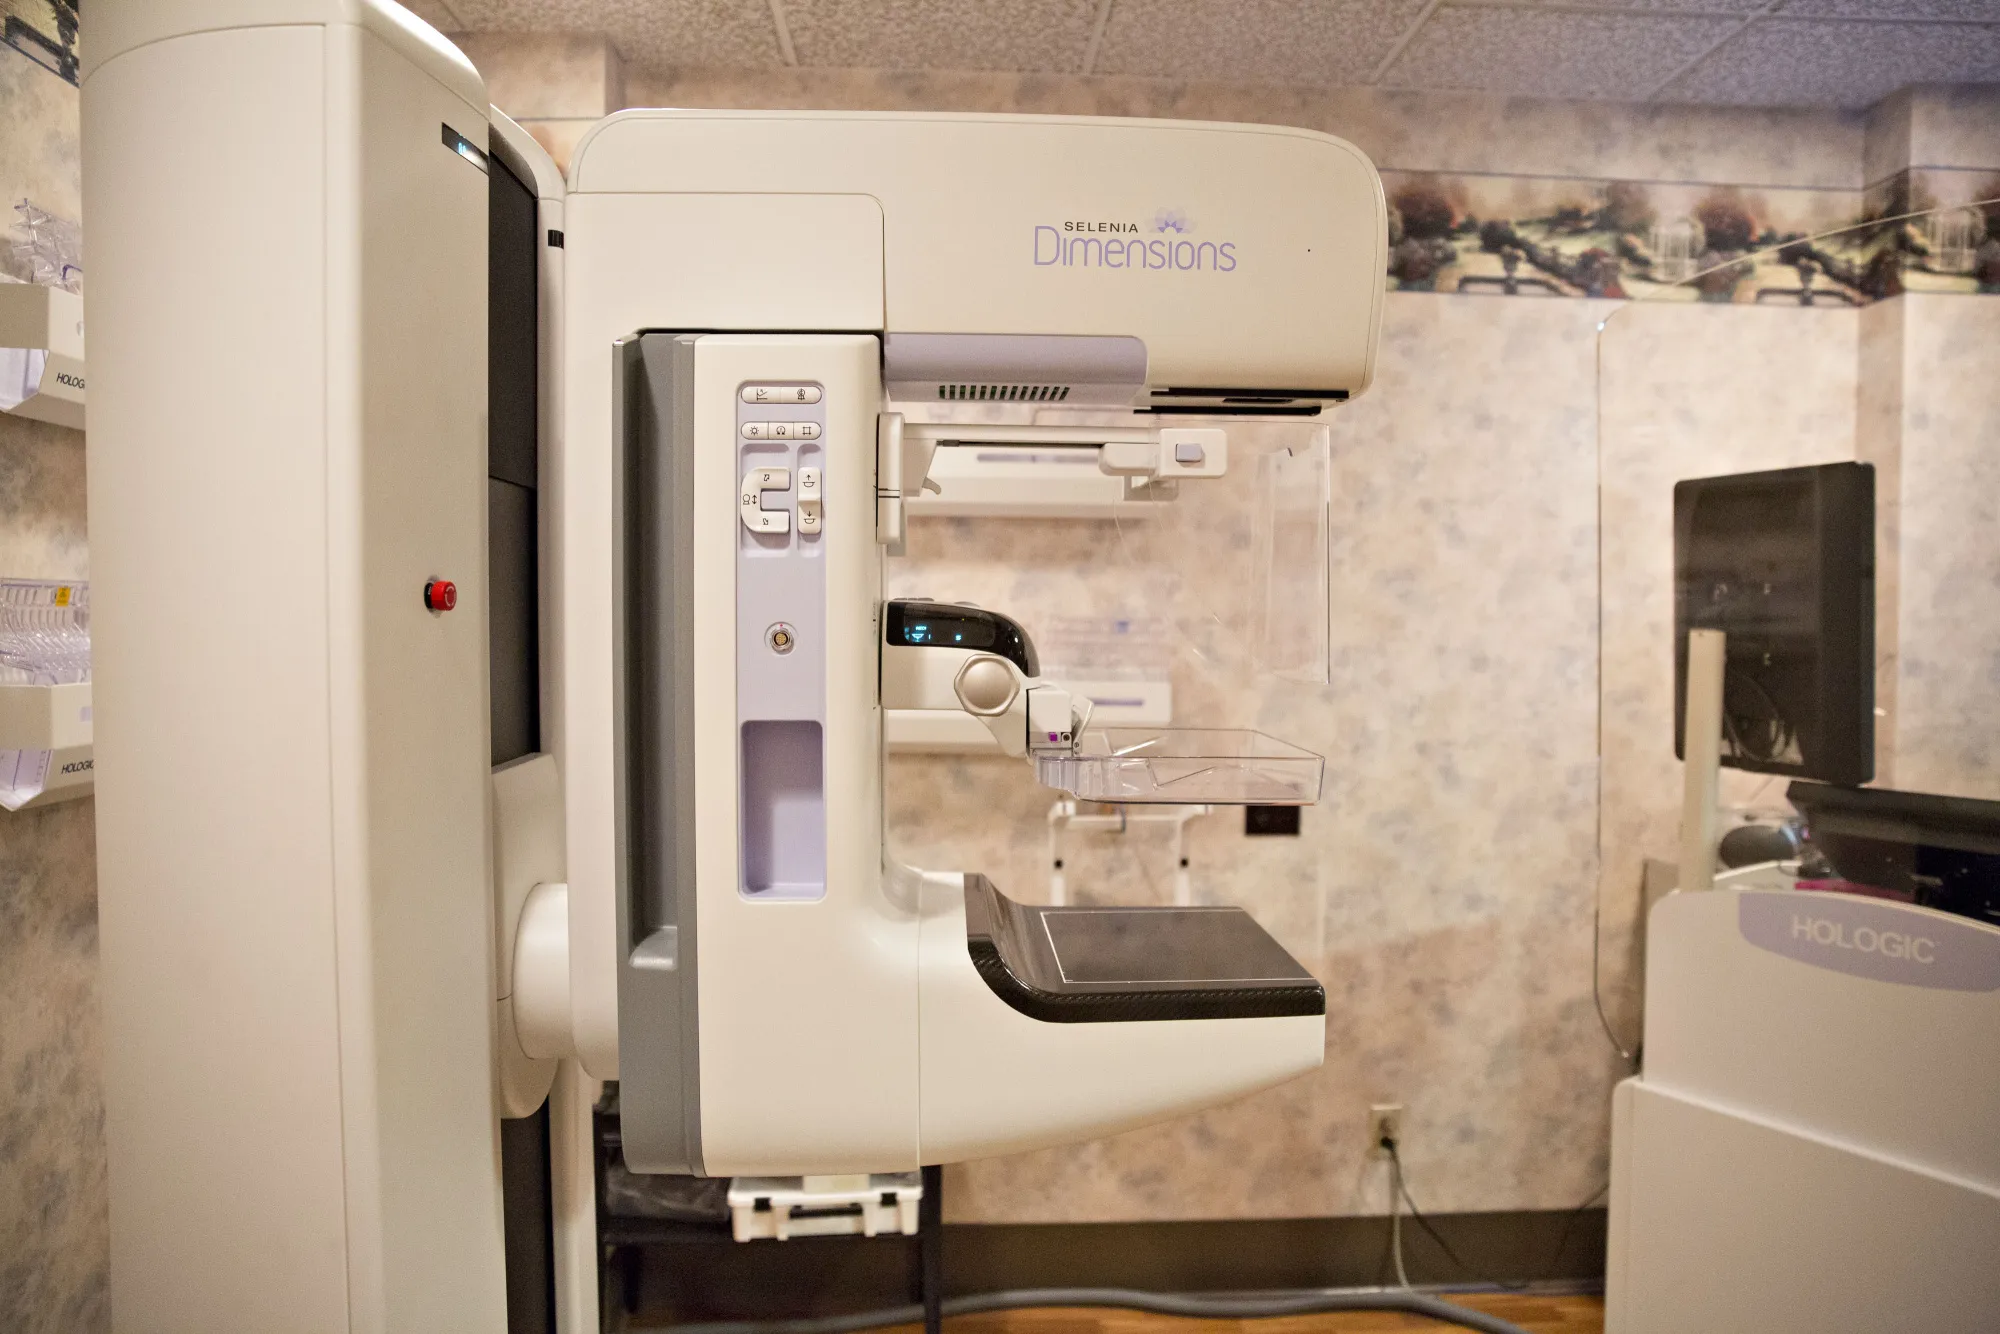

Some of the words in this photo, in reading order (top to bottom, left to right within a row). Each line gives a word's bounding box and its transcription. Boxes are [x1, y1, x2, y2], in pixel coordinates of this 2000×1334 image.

[1064, 221, 1139, 233] SELENIA
[1034, 225, 1237, 272] Dimensions
[56, 372, 85, 389] HOLOG
[1792, 915, 1935, 964] HOLOGIC
